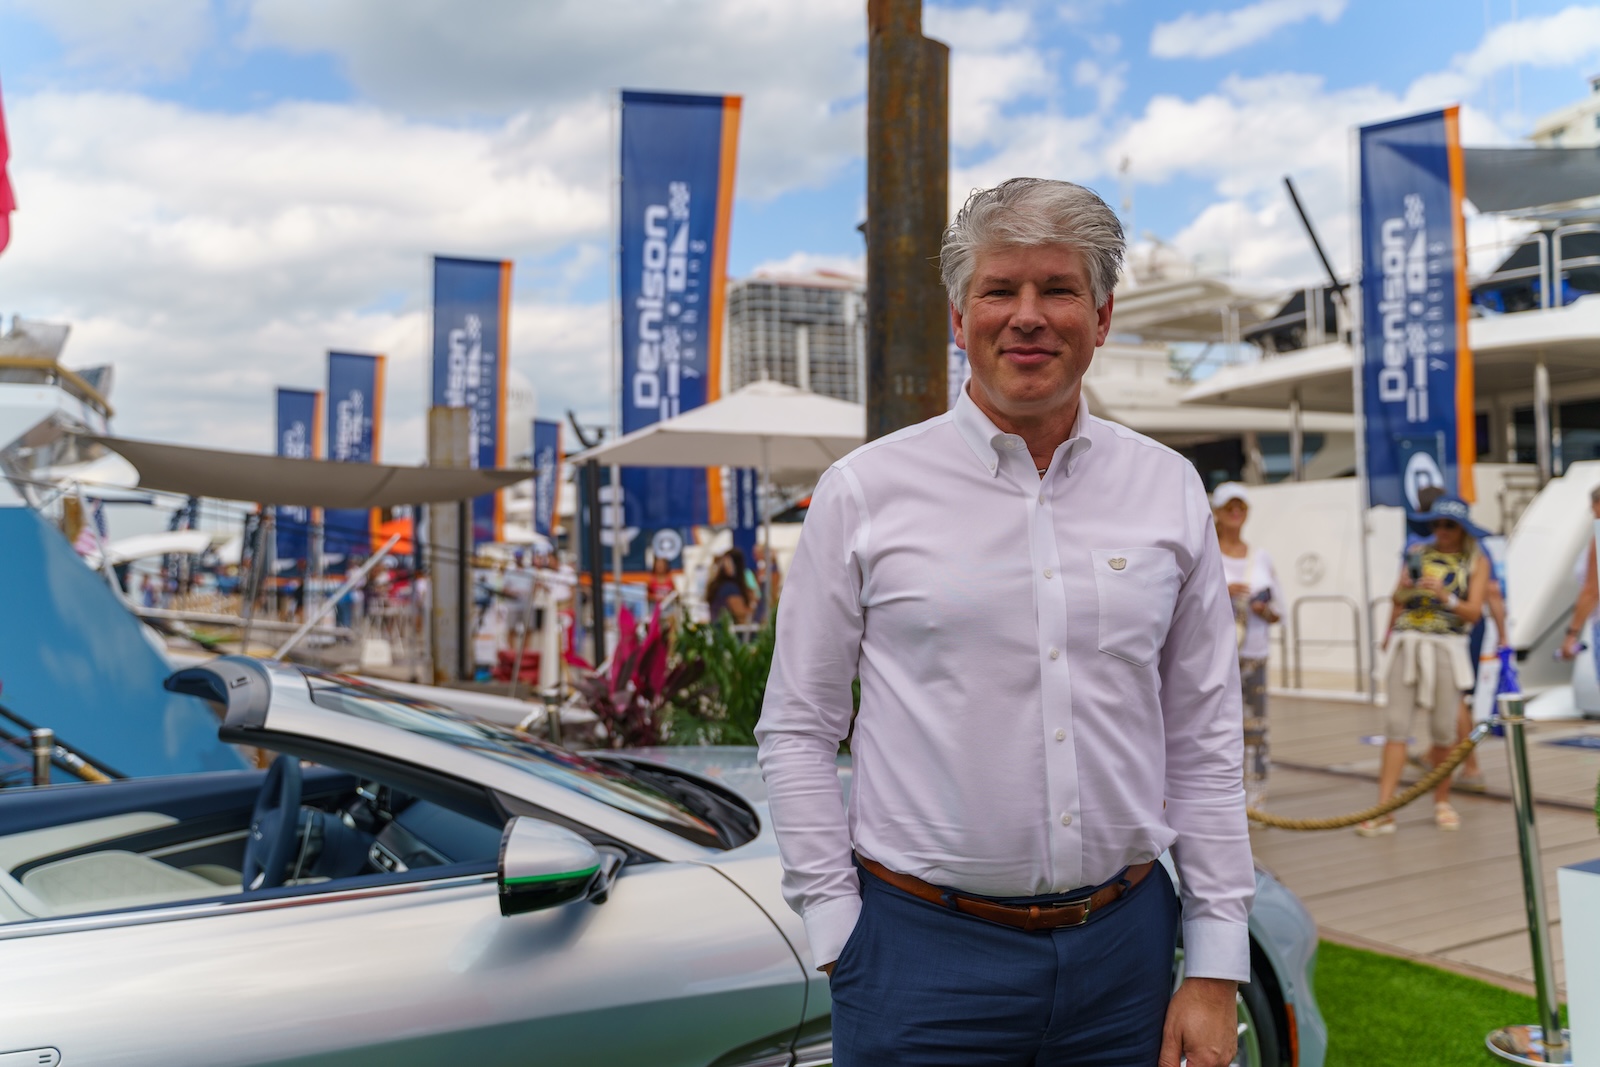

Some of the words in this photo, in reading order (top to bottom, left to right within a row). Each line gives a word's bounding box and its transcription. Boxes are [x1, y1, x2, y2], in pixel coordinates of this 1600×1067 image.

[632, 203, 669, 408] Denison
[681, 239, 707, 379] yachting
[1377, 216, 1408, 403] Denison
[1424, 240, 1449, 372] yachting
